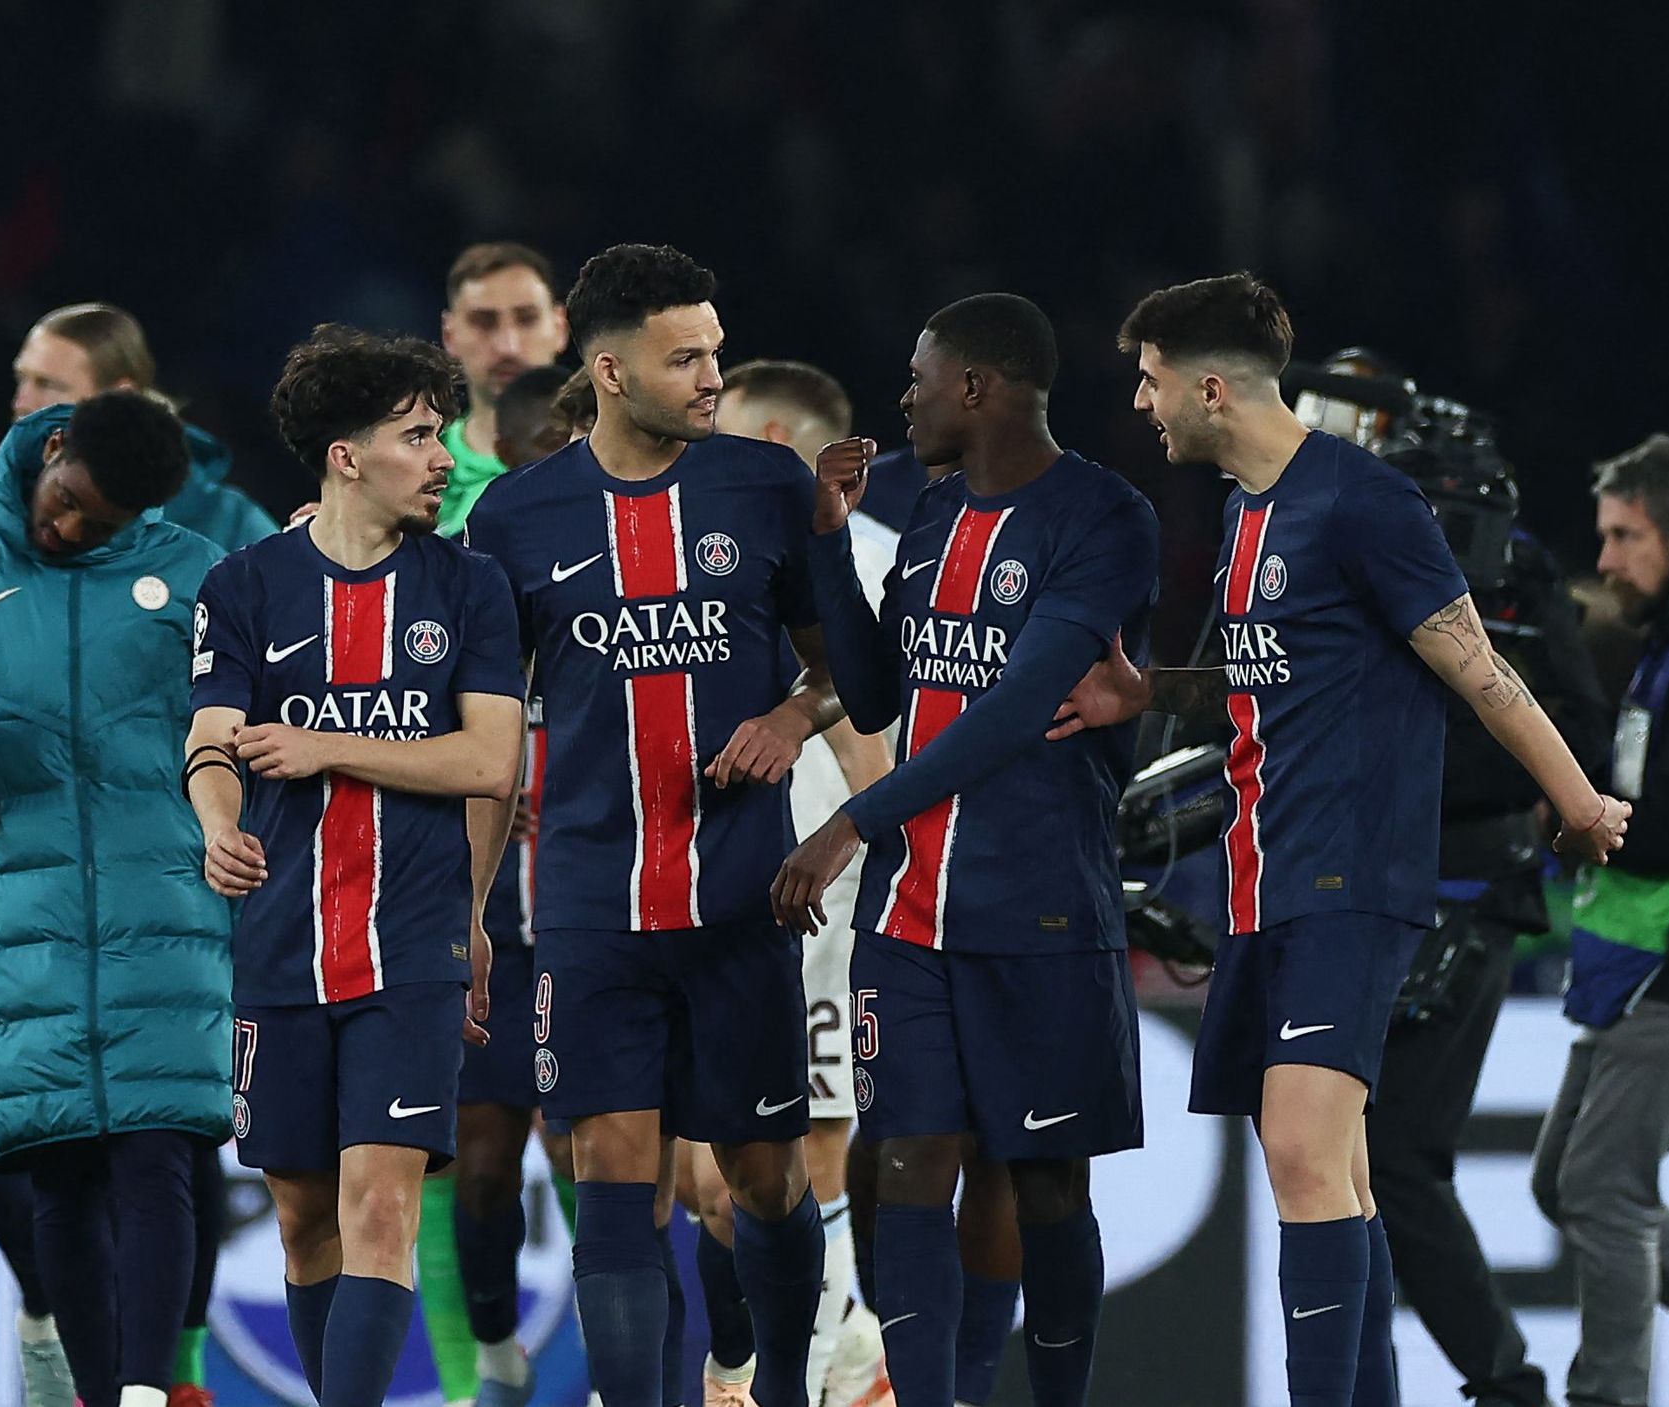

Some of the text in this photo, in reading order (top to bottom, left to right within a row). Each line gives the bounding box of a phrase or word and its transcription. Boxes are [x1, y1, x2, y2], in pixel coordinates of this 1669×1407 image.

[702, 535, 731, 546] PARIS
[1000, 563, 1023, 576] PARIS
[412, 622, 442, 634] PARIS
[572, 600, 729, 655] QATAR
[901, 615, 1008, 664] QATAR
[1220, 623, 1288, 660] TAR
[613, 638, 731, 671] AIRWAYS
[1225, 659, 1291, 687] RWAYS
[280, 689, 430, 730] QATAR
[534, 972, 552, 1044] 9
